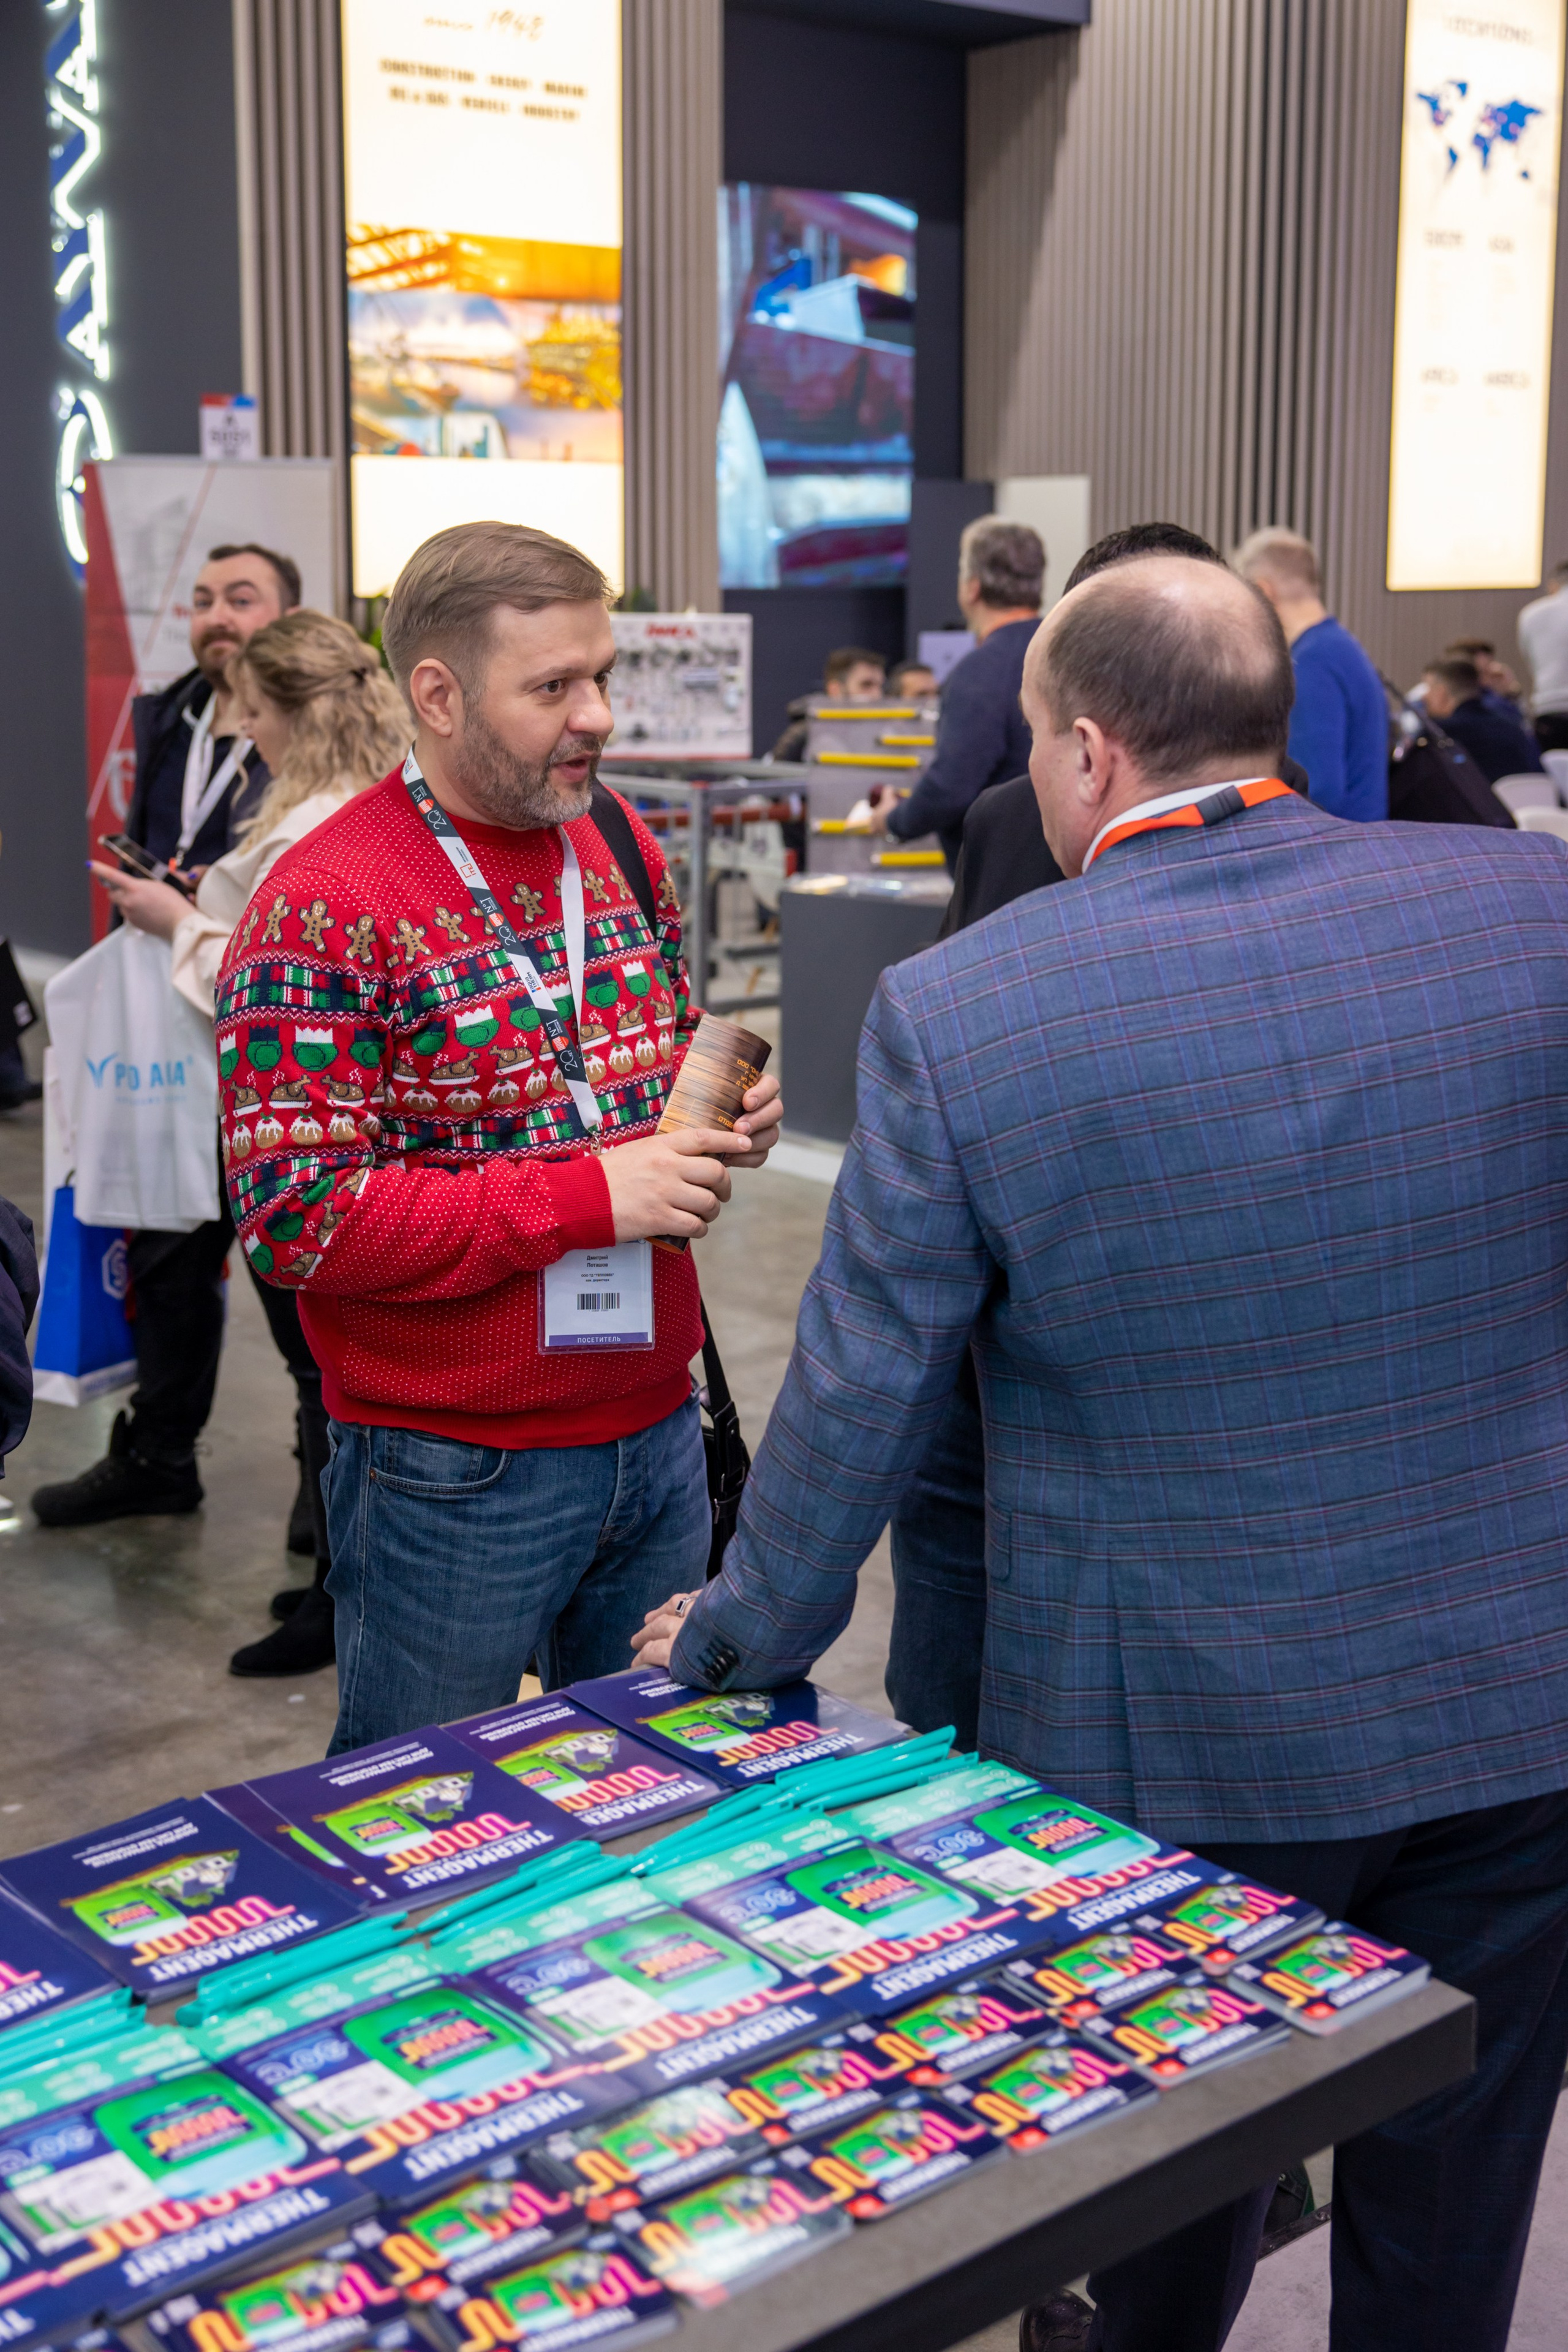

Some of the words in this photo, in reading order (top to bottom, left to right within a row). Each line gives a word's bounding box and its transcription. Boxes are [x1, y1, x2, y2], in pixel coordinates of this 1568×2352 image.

[737, 1733, 865, 1777] THERMAGENT
[579, 1780, 705, 1825] THERMAGEN
[402, 1830, 554, 1889] THERMAGENT
[1067, 1870, 1202, 1931] THERMAGENT
[149, 1915, 318, 1981] THERMAGENT
[871, 1932, 1019, 2000] THERMAGENT
[655, 2005, 817, 2079] THERMAGENT
[404, 2091, 584, 2181] THERMAGENT
[122, 2187, 330, 2286] THERMAGENT
